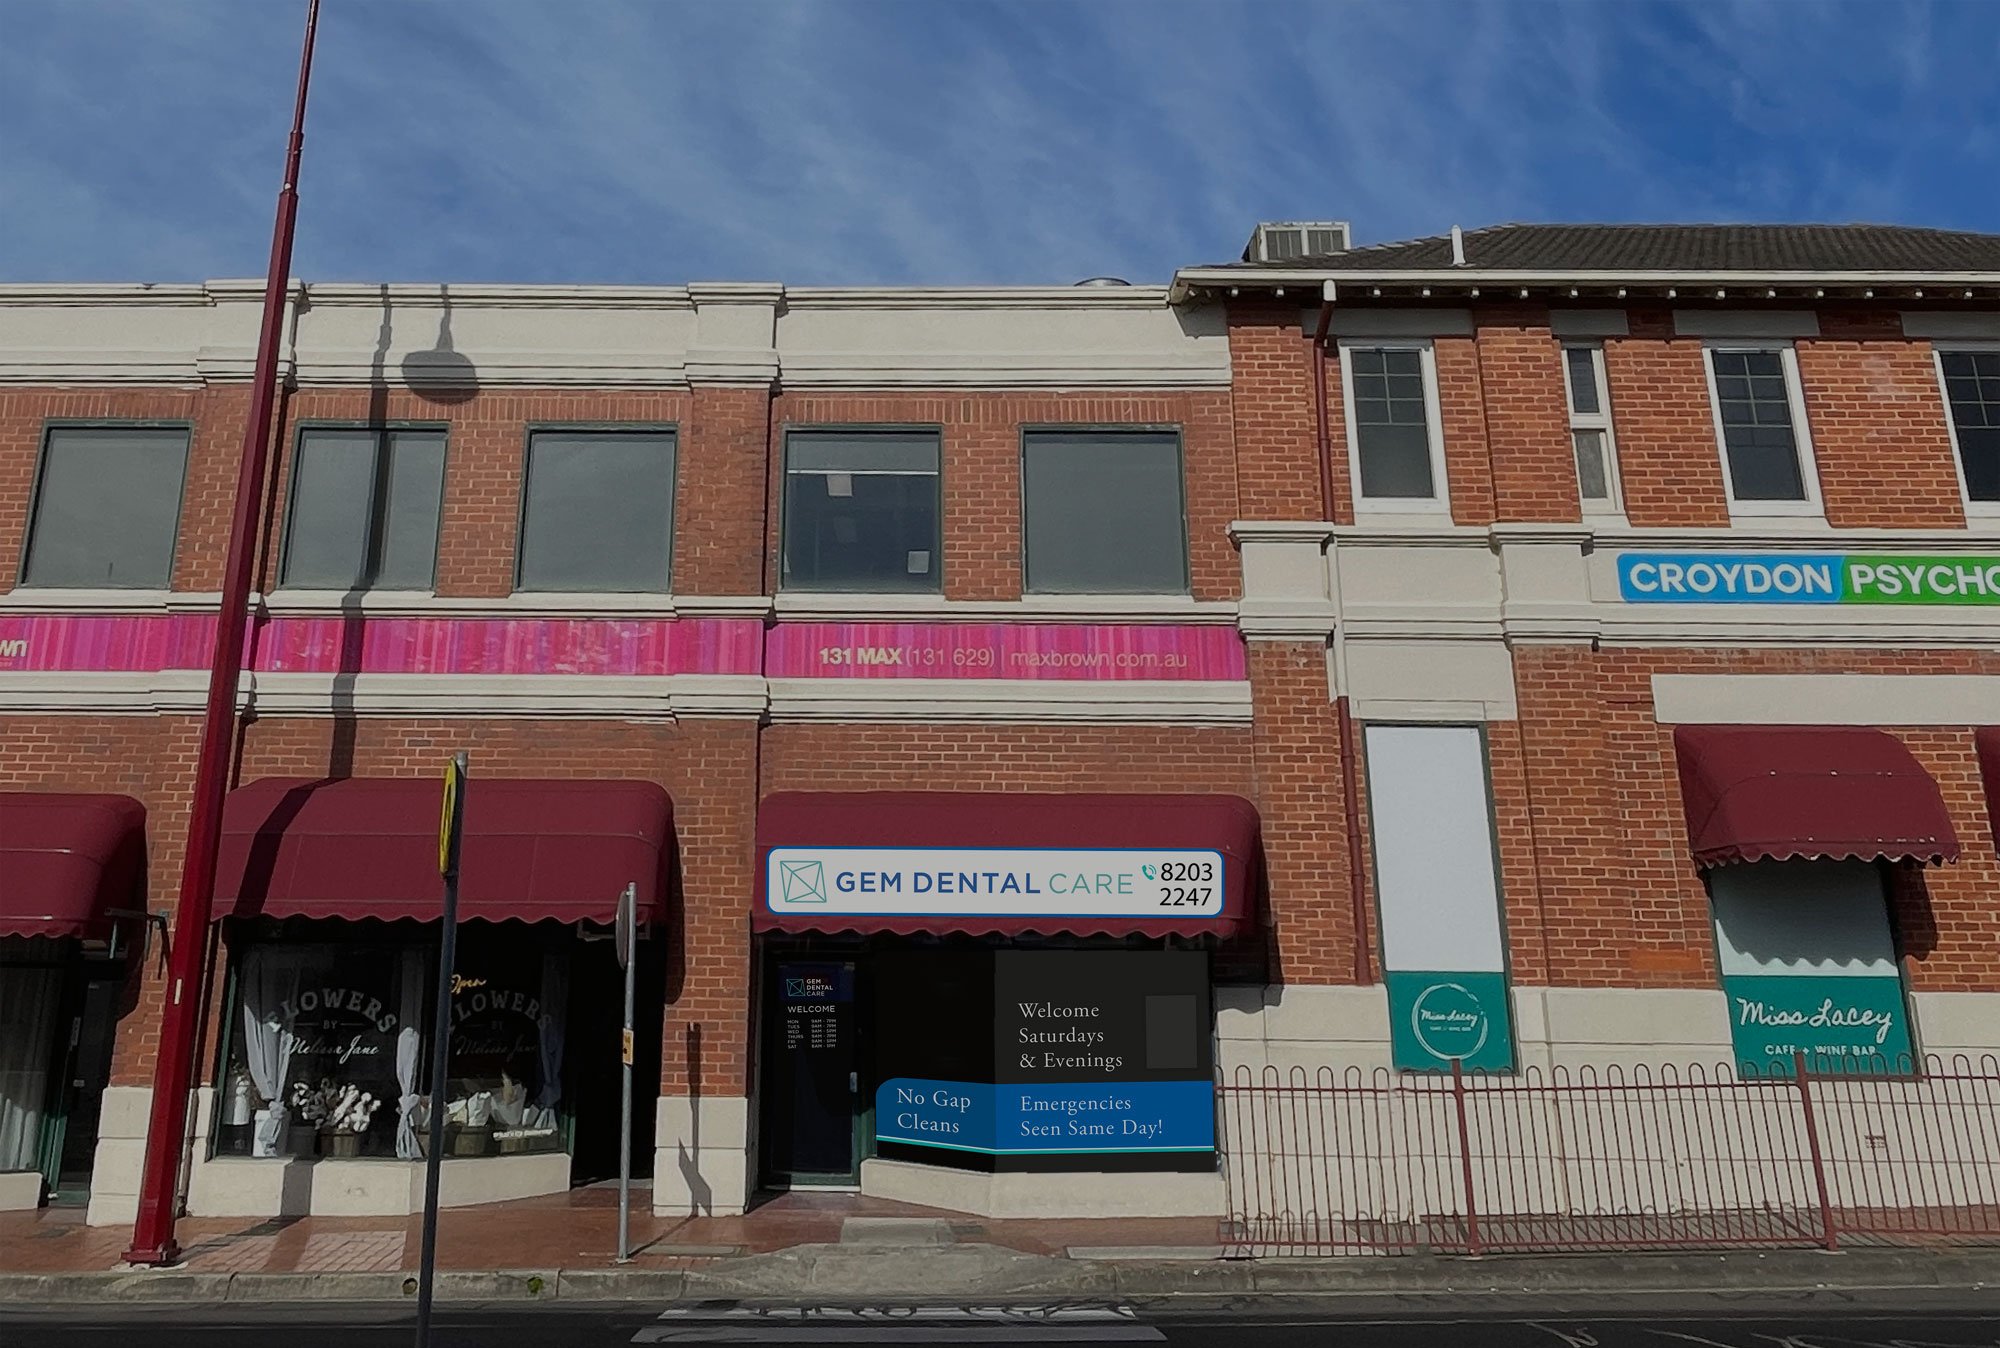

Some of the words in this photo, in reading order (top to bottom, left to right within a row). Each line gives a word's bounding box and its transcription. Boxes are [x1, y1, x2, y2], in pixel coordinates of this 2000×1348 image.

[1629, 563, 1834, 593] CROYDON
[819, 648, 851, 665] 131
[857, 648, 903, 664] MAX
[905, 647, 945, 668] (131
[953, 647, 995, 668] 629)
[1011, 648, 1188, 669] maxbrown.com.au
[1160, 862, 1213, 882] 8203
[836, 871, 902, 893] GEM
[913, 872, 1041, 894] DENTAL
[1049, 872, 1133, 895] CARE
[1159, 887, 1212, 906] 2247
[449, 990, 552, 1036] LOWERS
[787, 1005, 836, 1013] WELCOME
[1018, 1002, 1100, 1018] Welcome
[1421, 1009, 1446, 1021] Miss
[1447, 1009, 1478, 1028] Lacey
[323, 1019, 338, 1030] BY
[1736, 998, 1808, 1026] Miss
[1809, 998, 1893, 1044] Lacey
[1018, 1027, 1104, 1046] Saturdays
[1852, 1045, 1876, 1056] BAR
[1019, 1053, 1036, 1068] &
[1044, 1053, 1123, 1072] Evenings
[897, 1088, 925, 1105] No
[933, 1090, 971, 1113] Gap
[1020, 1095, 1131, 1115] Emergencies
[897, 1113, 960, 1133] Cleans
[1020, 1121, 1061, 1136] Seen
[1068, 1121, 1115, 1136] Same
[1122, 1119, 1163, 1139] Day!
